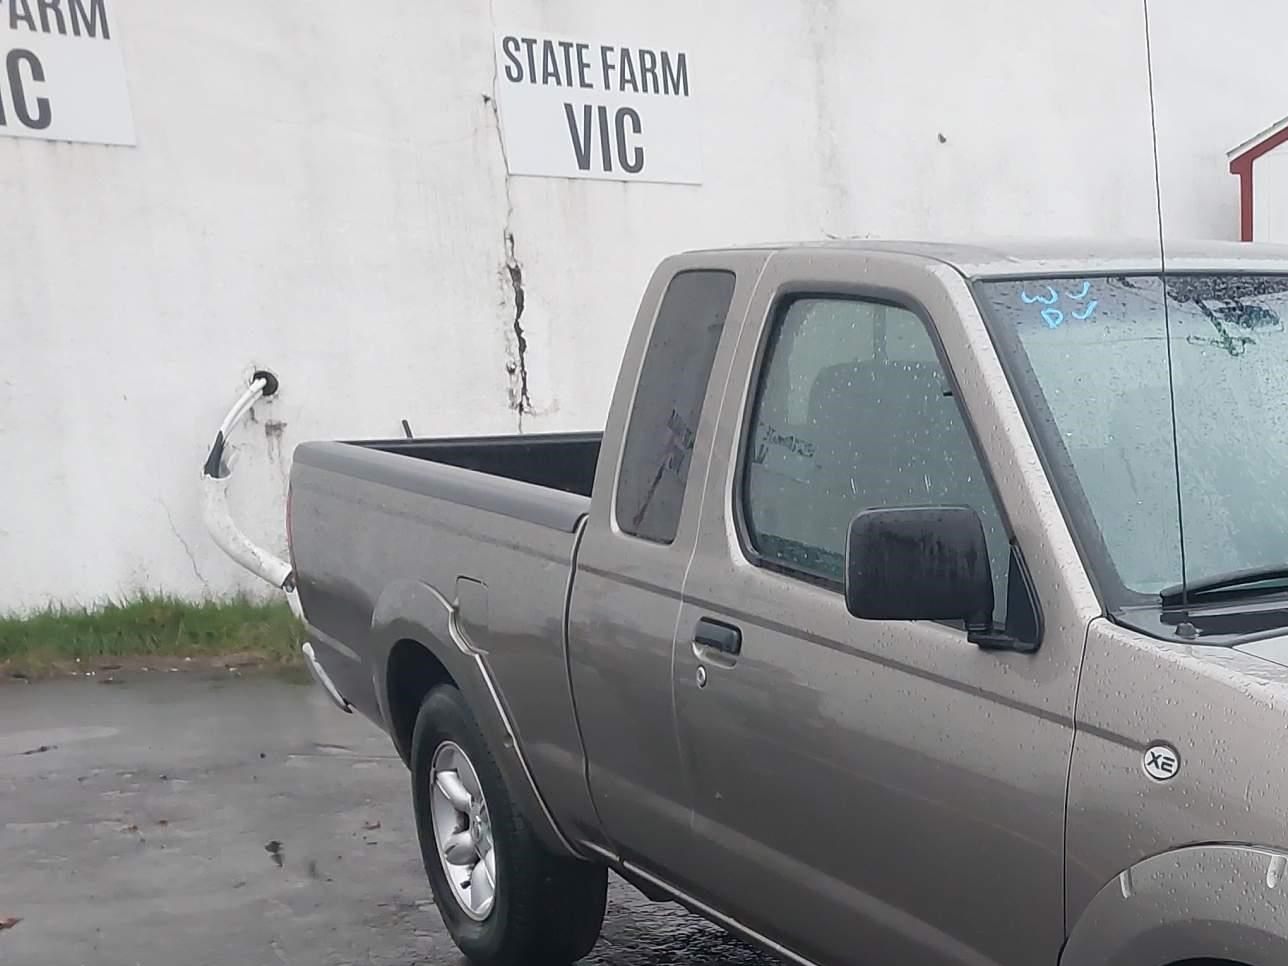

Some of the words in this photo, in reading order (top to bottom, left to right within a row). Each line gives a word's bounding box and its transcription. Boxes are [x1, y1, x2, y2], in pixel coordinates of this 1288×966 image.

[0, 0, 110, 40] ARM
[502, 36, 594, 89] STATE
[600, 45, 690, 97] FARM
[563, 102, 644, 174] VIC
[1146, 751, 1176, 774] XE
